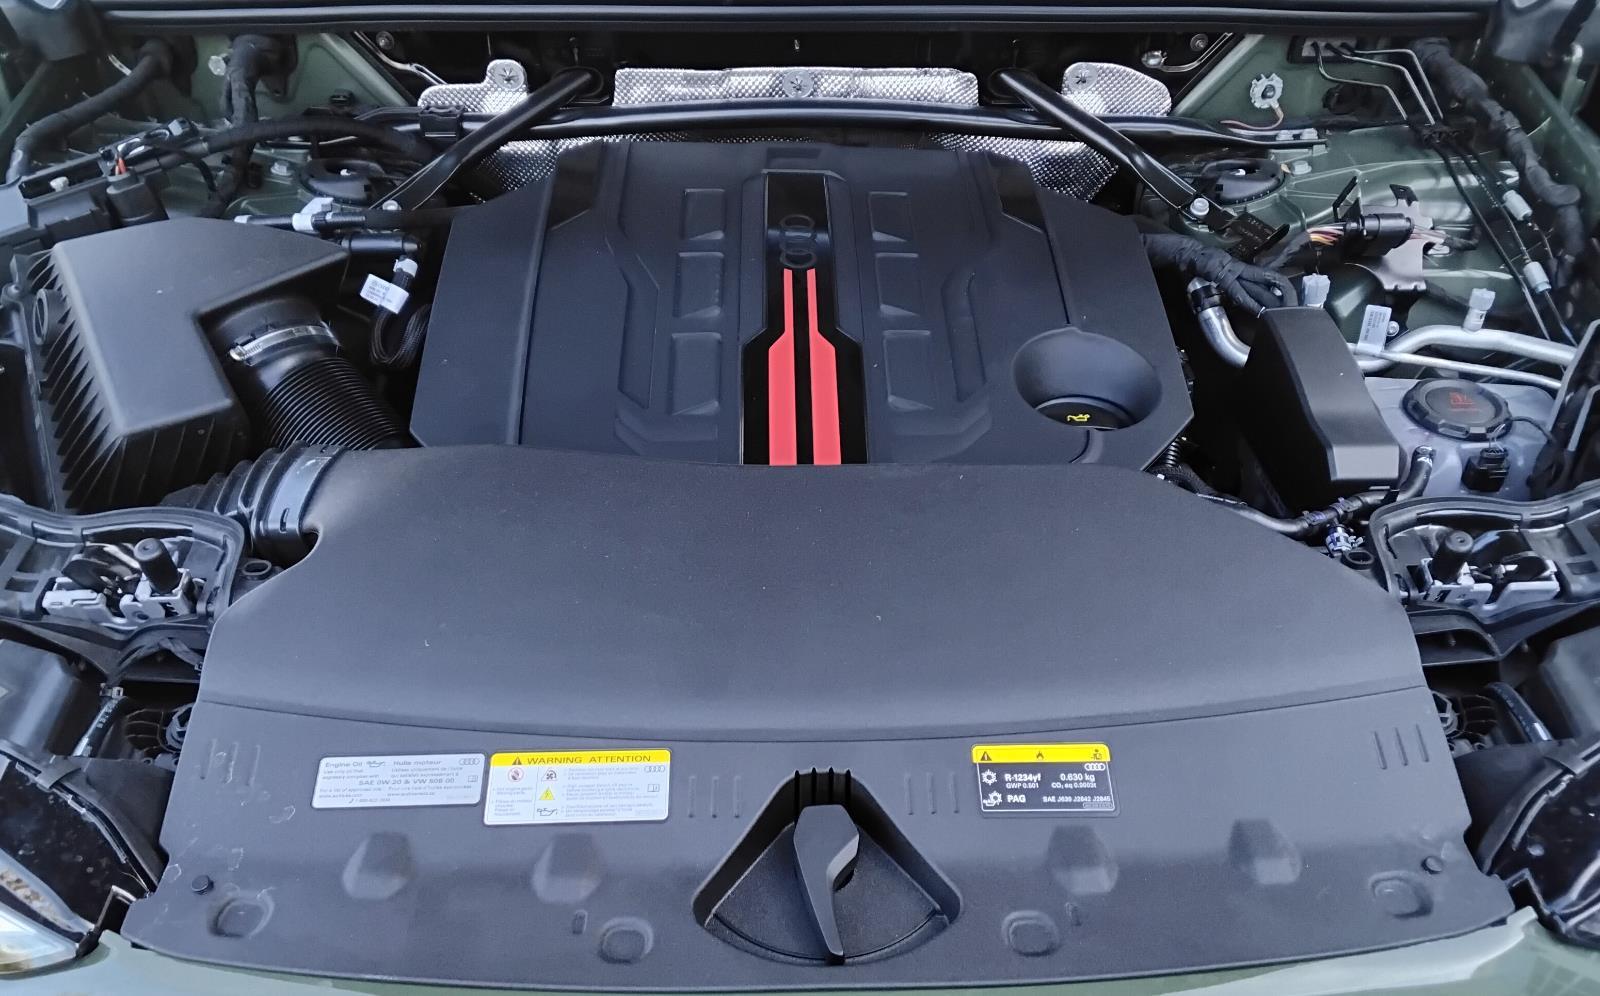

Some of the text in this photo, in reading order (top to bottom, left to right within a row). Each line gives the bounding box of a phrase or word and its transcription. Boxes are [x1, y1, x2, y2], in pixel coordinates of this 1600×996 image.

[527, 755, 651, 764] WARNING ATTENTION
[1004, 773, 1041, 782] R-1234yf
[1059, 773, 1096, 782] 0.630 kg
[1006, 794, 1026, 803] PAG
